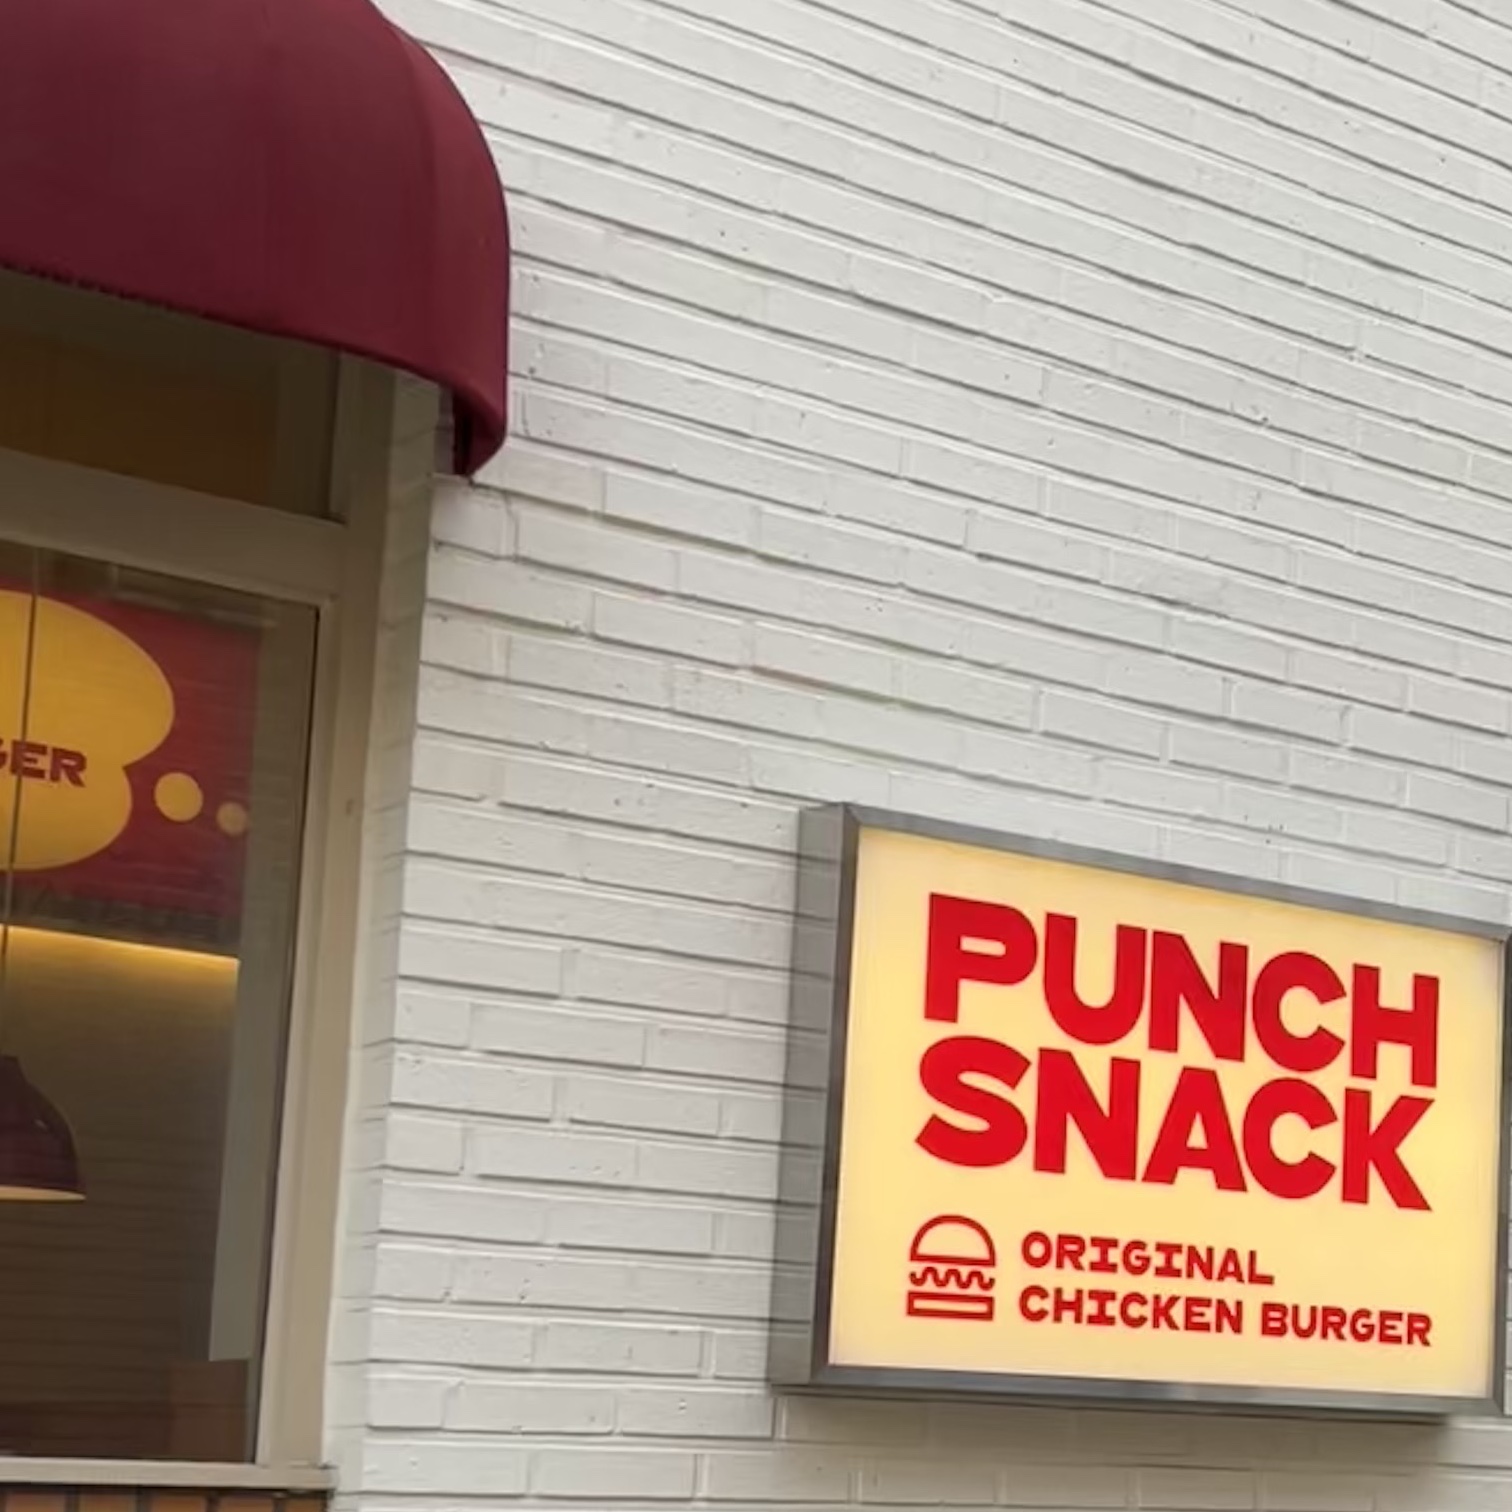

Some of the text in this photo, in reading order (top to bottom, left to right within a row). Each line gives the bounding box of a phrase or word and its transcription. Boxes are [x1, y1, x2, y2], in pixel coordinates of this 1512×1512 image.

[0, 737, 88, 788] ER
[923, 893, 1440, 1090] PUNCH
[914, 1034, 1434, 1212] SNACK
[1020, 1230, 1274, 1287] ORIGINAL
[1017, 1284, 1433, 1348] CHICKEN BURGER
